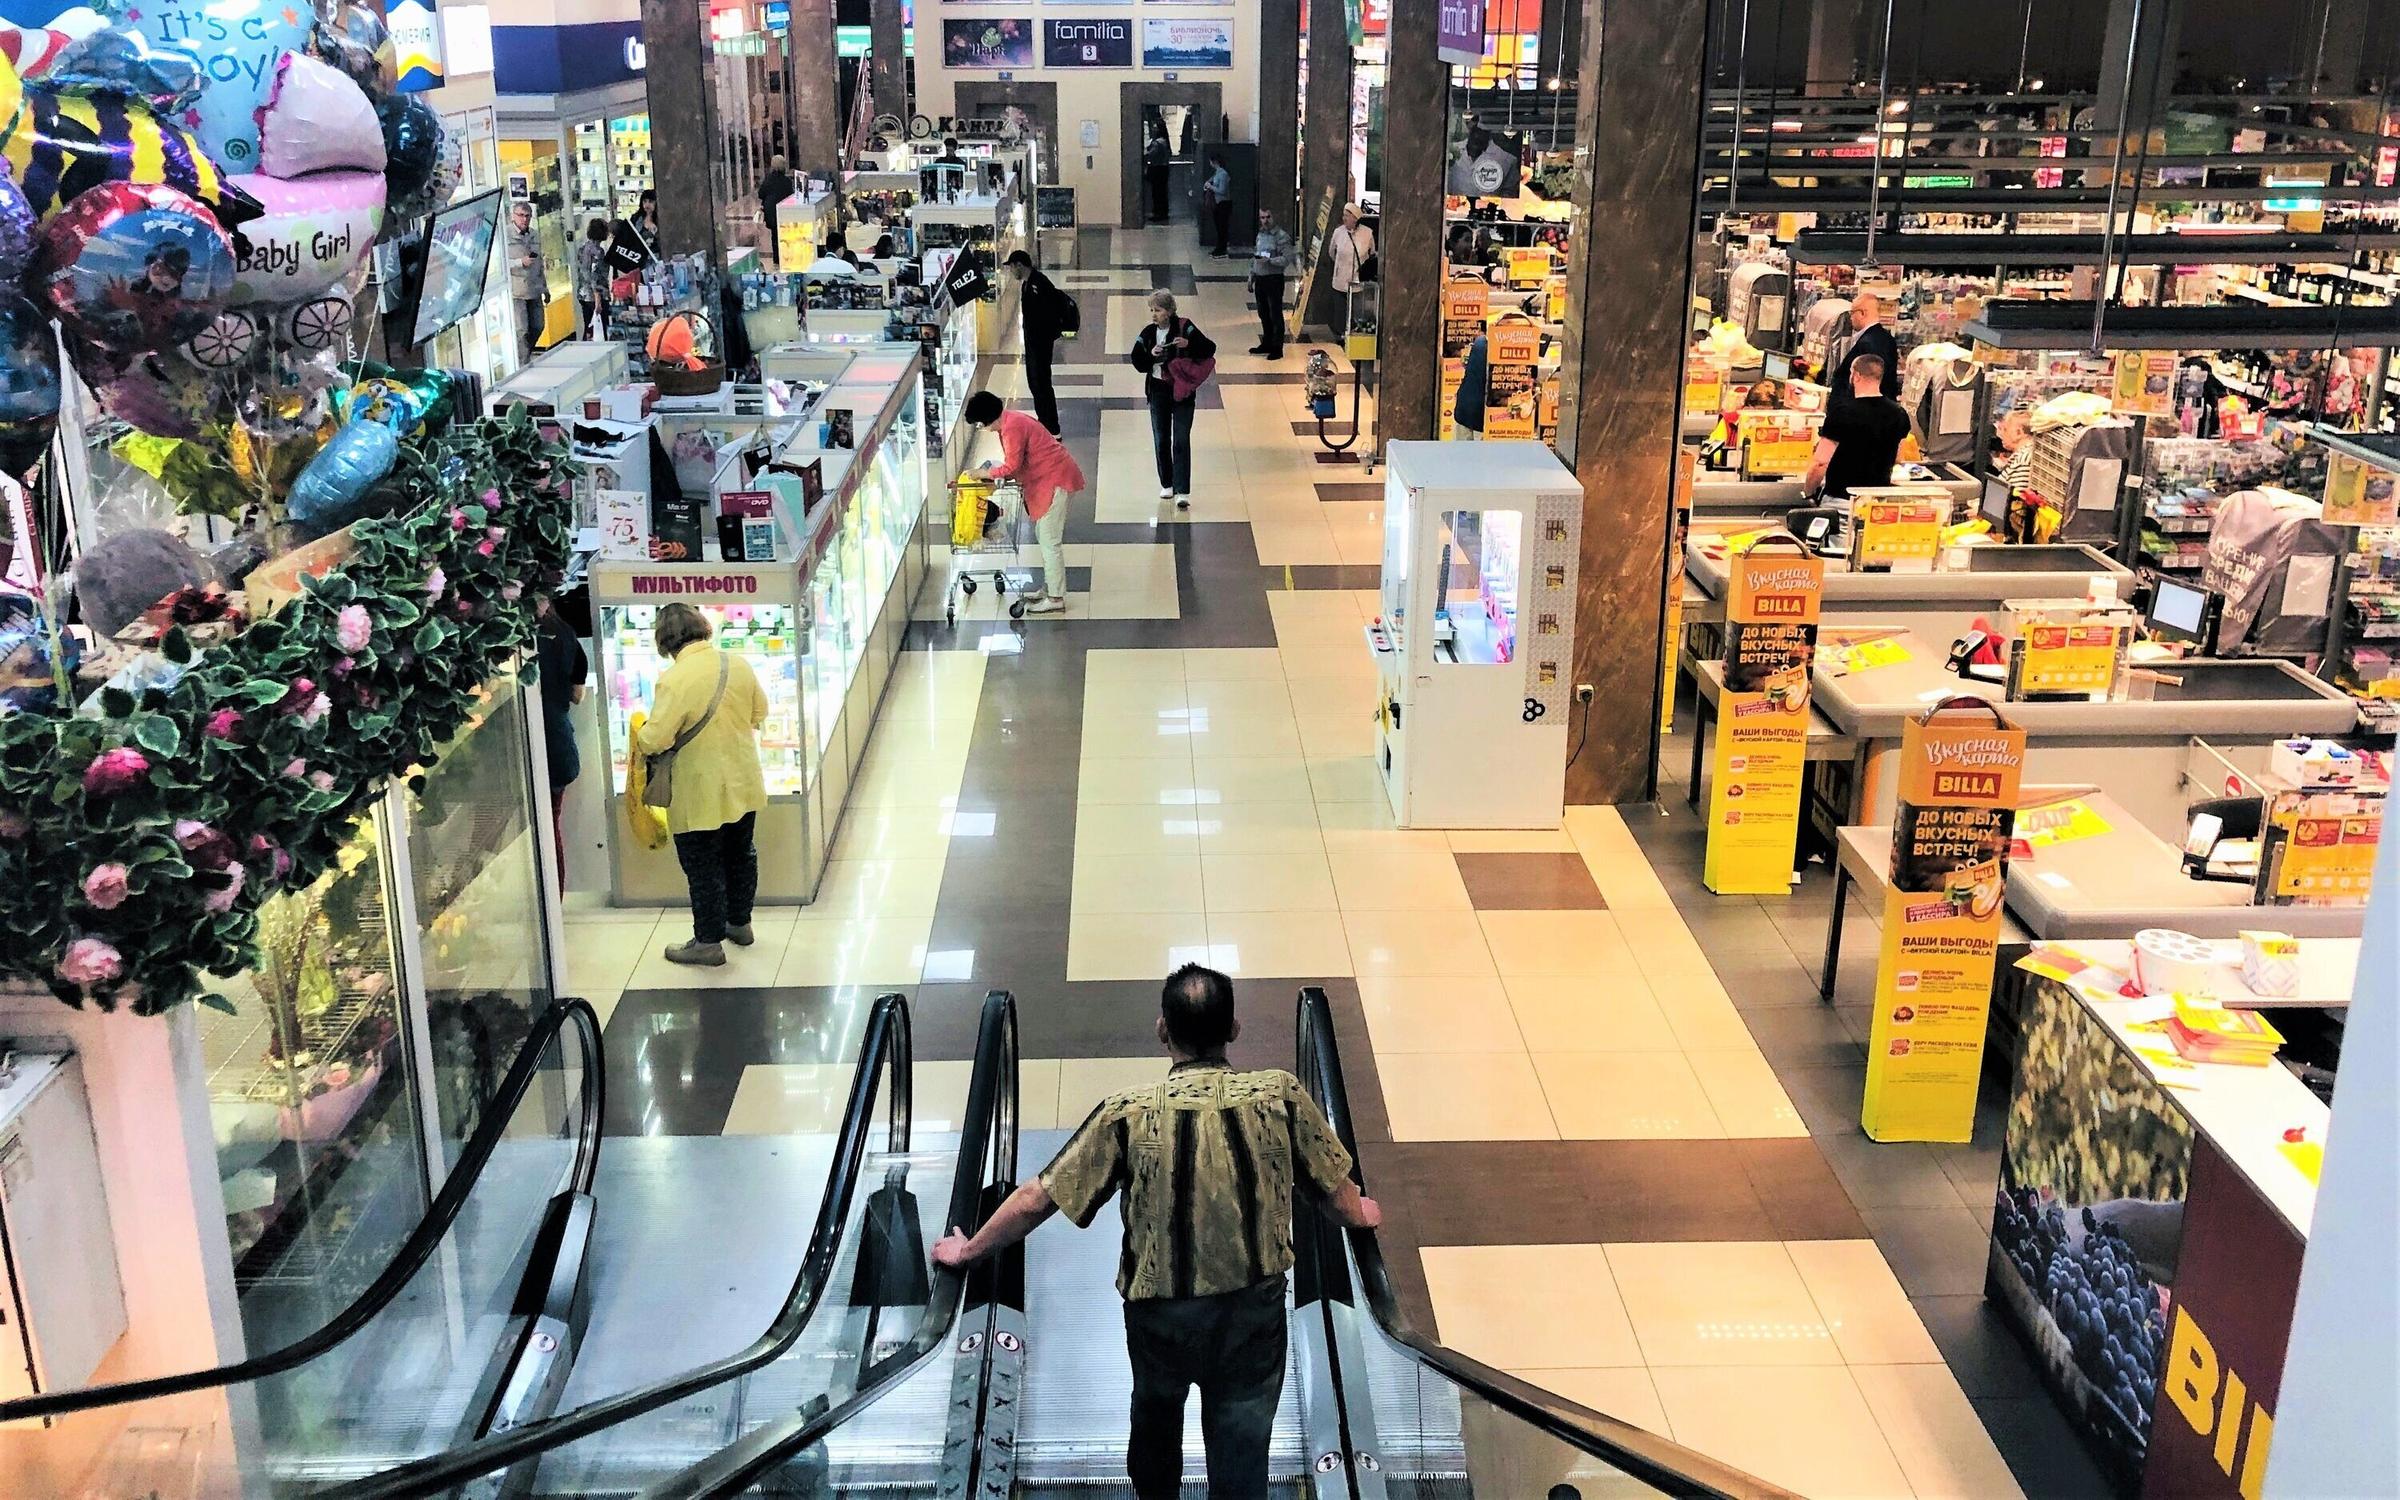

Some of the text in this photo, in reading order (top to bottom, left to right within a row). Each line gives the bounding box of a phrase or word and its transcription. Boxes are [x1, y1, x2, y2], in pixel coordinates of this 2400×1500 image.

[157, 9, 228, 42] It's
[1055, 21, 1124, 39] familia
[1085, 46, 1093, 56] 3
[236, 222, 351, 277] Baby Girl
[615, 245, 642, 264] TELE2
[951, 269, 977, 290] TELE2
[1455, 305, 1479, 315] BILLA
[1501, 348, 1529, 358] BILLA
[1492, 366, 1504, 375] ДО
[612, 517, 634, 537] 75
[632, 575, 757, 594] МУЛЬТИФОТО
[1747, 568, 1810, 591] Вкусная
[1757, 598, 1801, 613] BILLA
[1741, 627, 1807, 639] ДО НОВЫХ
[1740, 639, 1801, 651] ВКУСНЫХ
[1739, 652, 1790, 664] ВСТРЕЧ!
[1732, 728, 1804, 738] ВАШИ ВЫГОДЫ
[1925, 739, 2010, 766] Вкусная
[1962, 751, 2020, 768] карта
[1938, 776, 1996, 794] BILLA
[1916, 811, 2002, 827] ДО НОВЫХ
[1914, 826, 1995, 841] ВКУСНЫХ
[1913, 842, 1979, 857] ВСТРЕЧ!
[1902, 937, 1993, 949] ВАШИ ВЫГОДЫ
